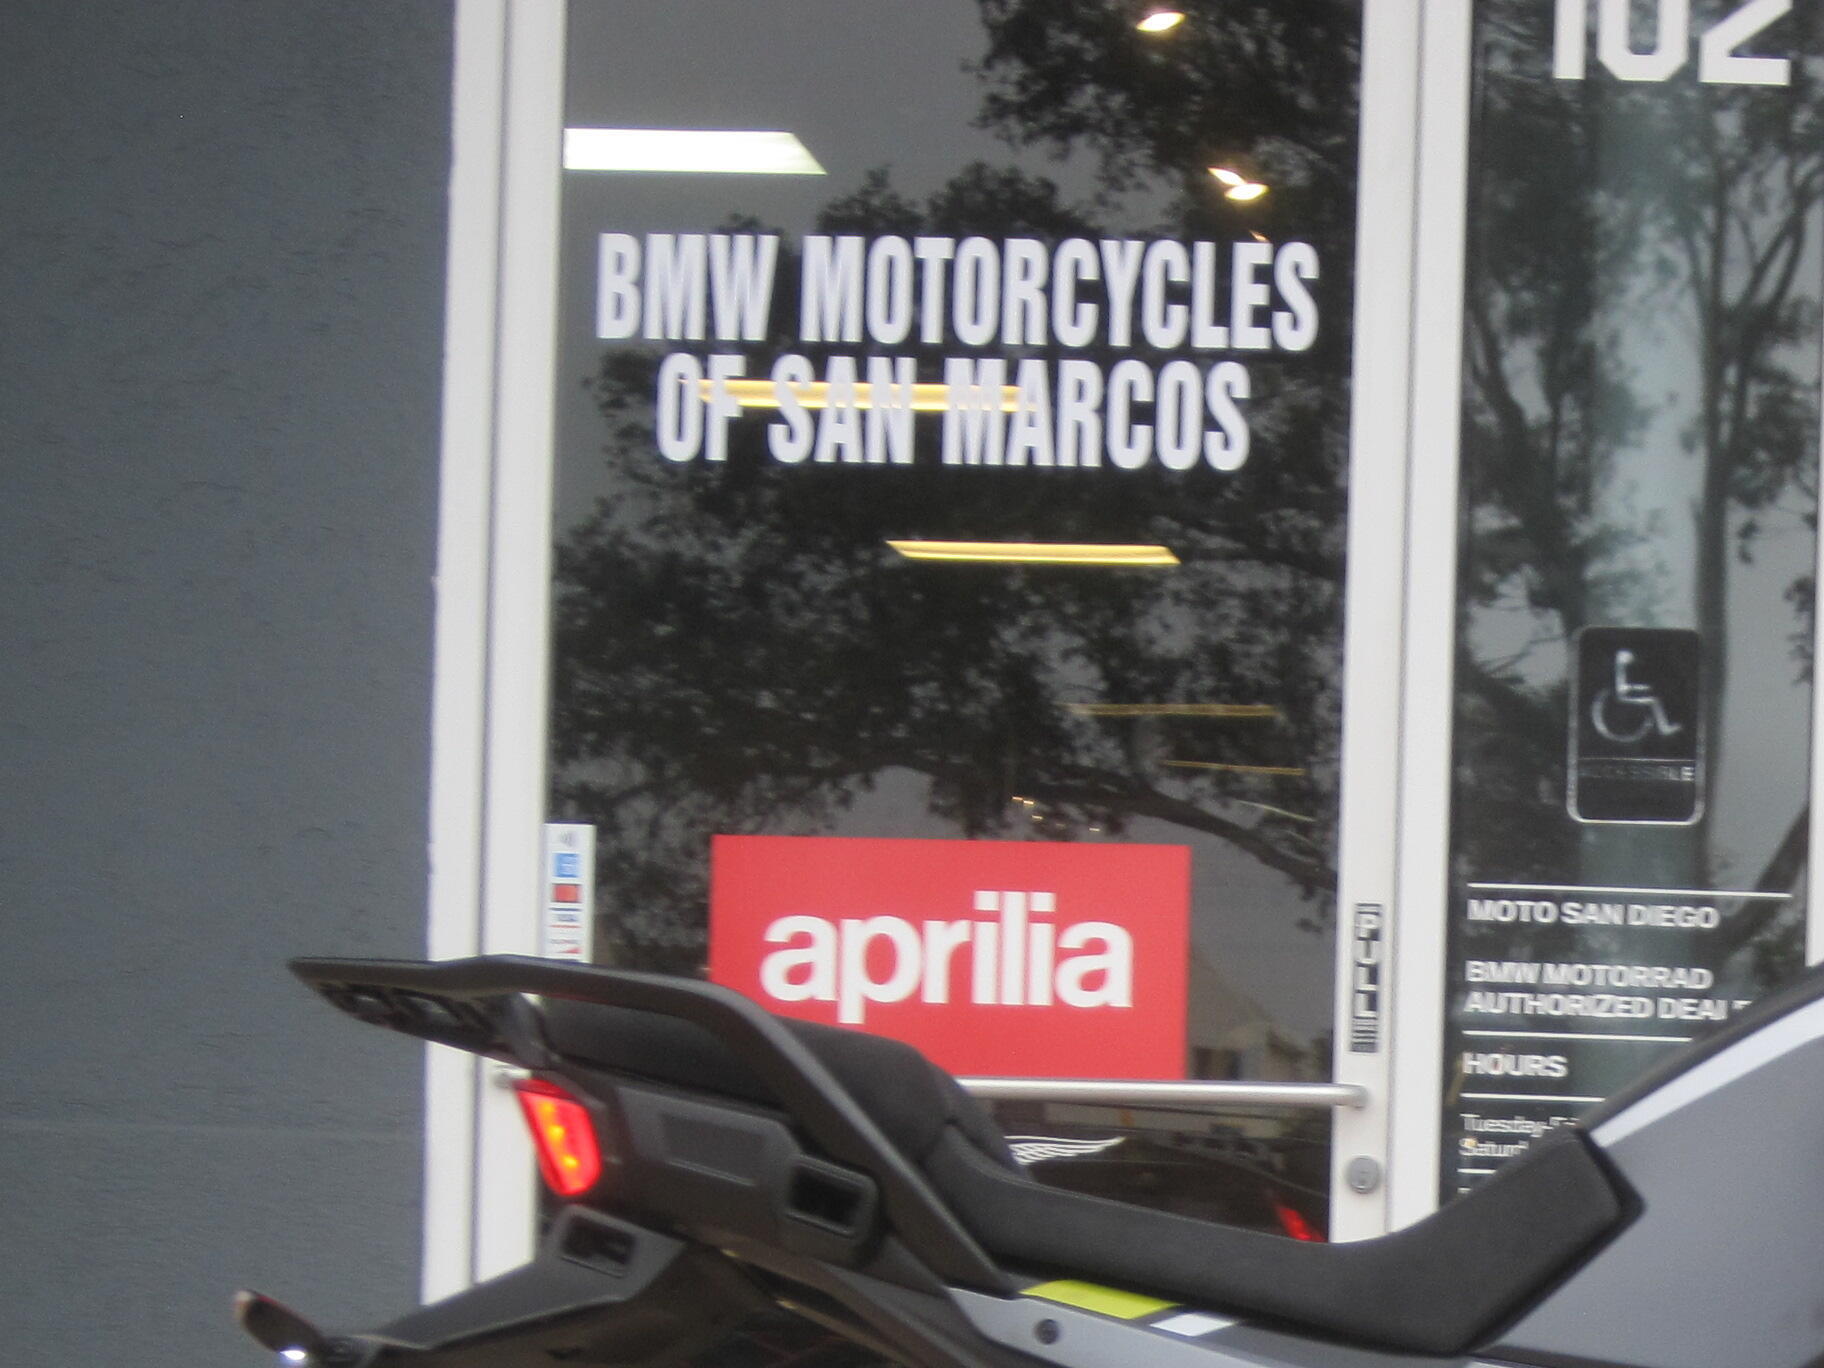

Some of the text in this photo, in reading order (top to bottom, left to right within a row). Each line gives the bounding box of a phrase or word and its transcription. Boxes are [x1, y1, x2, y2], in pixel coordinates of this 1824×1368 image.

[1552, 0, 1792, 86] 102
[597, 232, 1321, 352] BMW MOTORCYCLES
[656, 354, 1251, 471] OF SAN MARCOS
[1466, 899, 1720, 929] MOTO SAN DIEGO
[758, 889, 1135, 1025] aprilia
[1465, 960, 1714, 989] BMW MOTORRAD
[1463, 991, 1655, 1018] AUTHORIZED
[1462, 1051, 1569, 1078] HOURS
